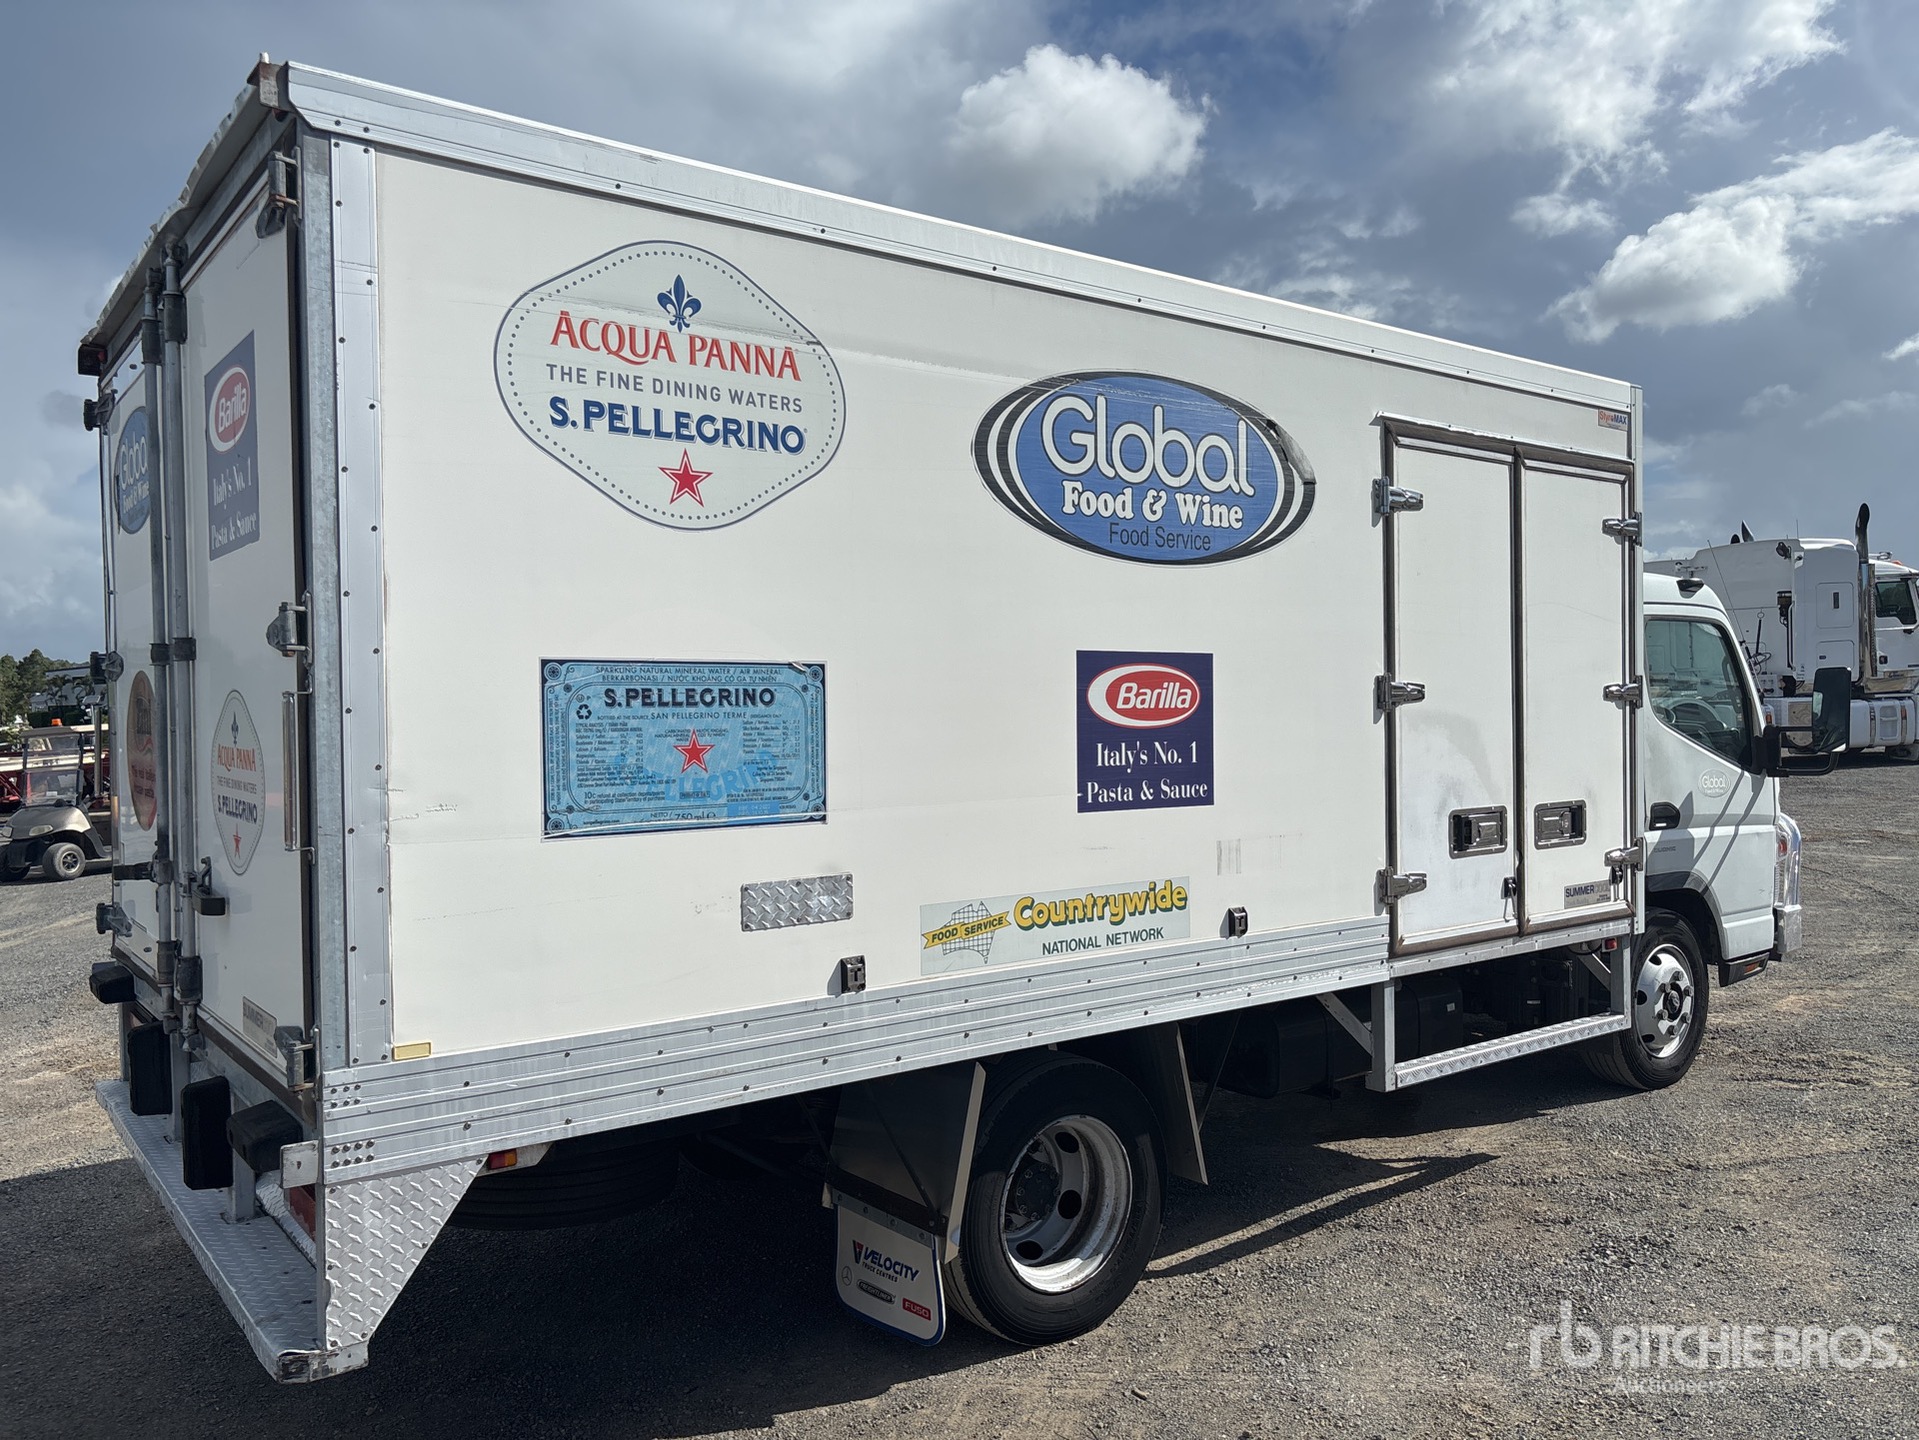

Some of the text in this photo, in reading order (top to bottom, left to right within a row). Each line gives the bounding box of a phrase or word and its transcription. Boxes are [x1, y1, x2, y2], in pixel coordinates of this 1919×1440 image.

[550, 310, 802, 382] ACQUA PANNA
[546, 363, 802, 413] THE FINE DINING WATERS
[218, 382, 247, 434] Barilla
[549, 396, 807, 455] S.PELLEGRINO
[1042, 393, 1256, 497] Global
[120, 431, 148, 491] Globa
[247, 456, 252, 487] 1
[1062, 480, 1244, 529] Food & Wine
[211, 523, 228, 550] Pasta
[1109, 523, 1211, 551] Food Service
[640, 667, 673, 675] NATURAL
[604, 688, 776, 708] S.PELLEGRINO
[1116, 682, 1192, 709] Barilla
[651, 712, 668, 720] SAN
[672, 712, 720, 720] PELLEGRINO
[217, 744, 257, 773] ACQUA PANNA
[1096, 741, 1197, 773] Italy's No. 1
[1086, 778, 1208, 803] Pasta & Sauce
[1702, 775, 1726, 788] Global
[1013, 879, 1188, 931] Countrywide
[931, 915, 1004, 943] FOOD SERVICE
[1042, 927, 1164, 956] NATIONAL NETWORK
[862, 1261, 876, 1273] TRUCK
[863, 1247, 920, 1282] VELOCITY
[905, 1301, 929, 1317] FUSO
